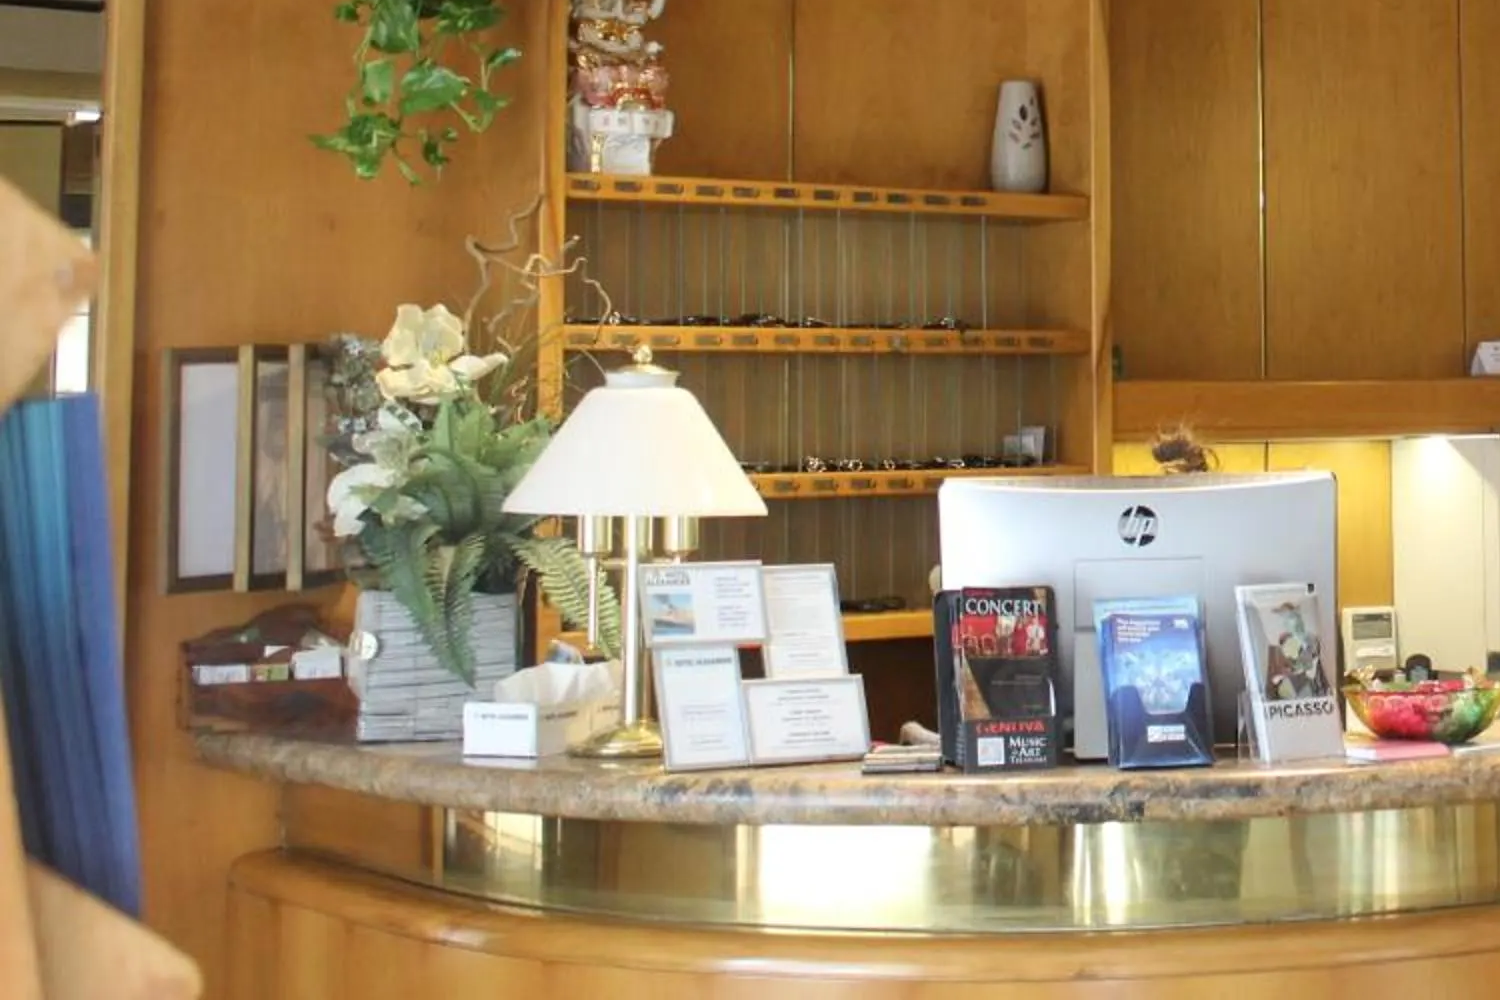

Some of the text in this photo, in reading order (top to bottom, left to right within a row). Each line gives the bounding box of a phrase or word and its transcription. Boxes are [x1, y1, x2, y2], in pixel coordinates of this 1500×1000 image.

[1121, 505, 1156, 546] hp
[965, 598, 1043, 616] CONCERT
[1268, 700, 1333, 719] PICASSO
